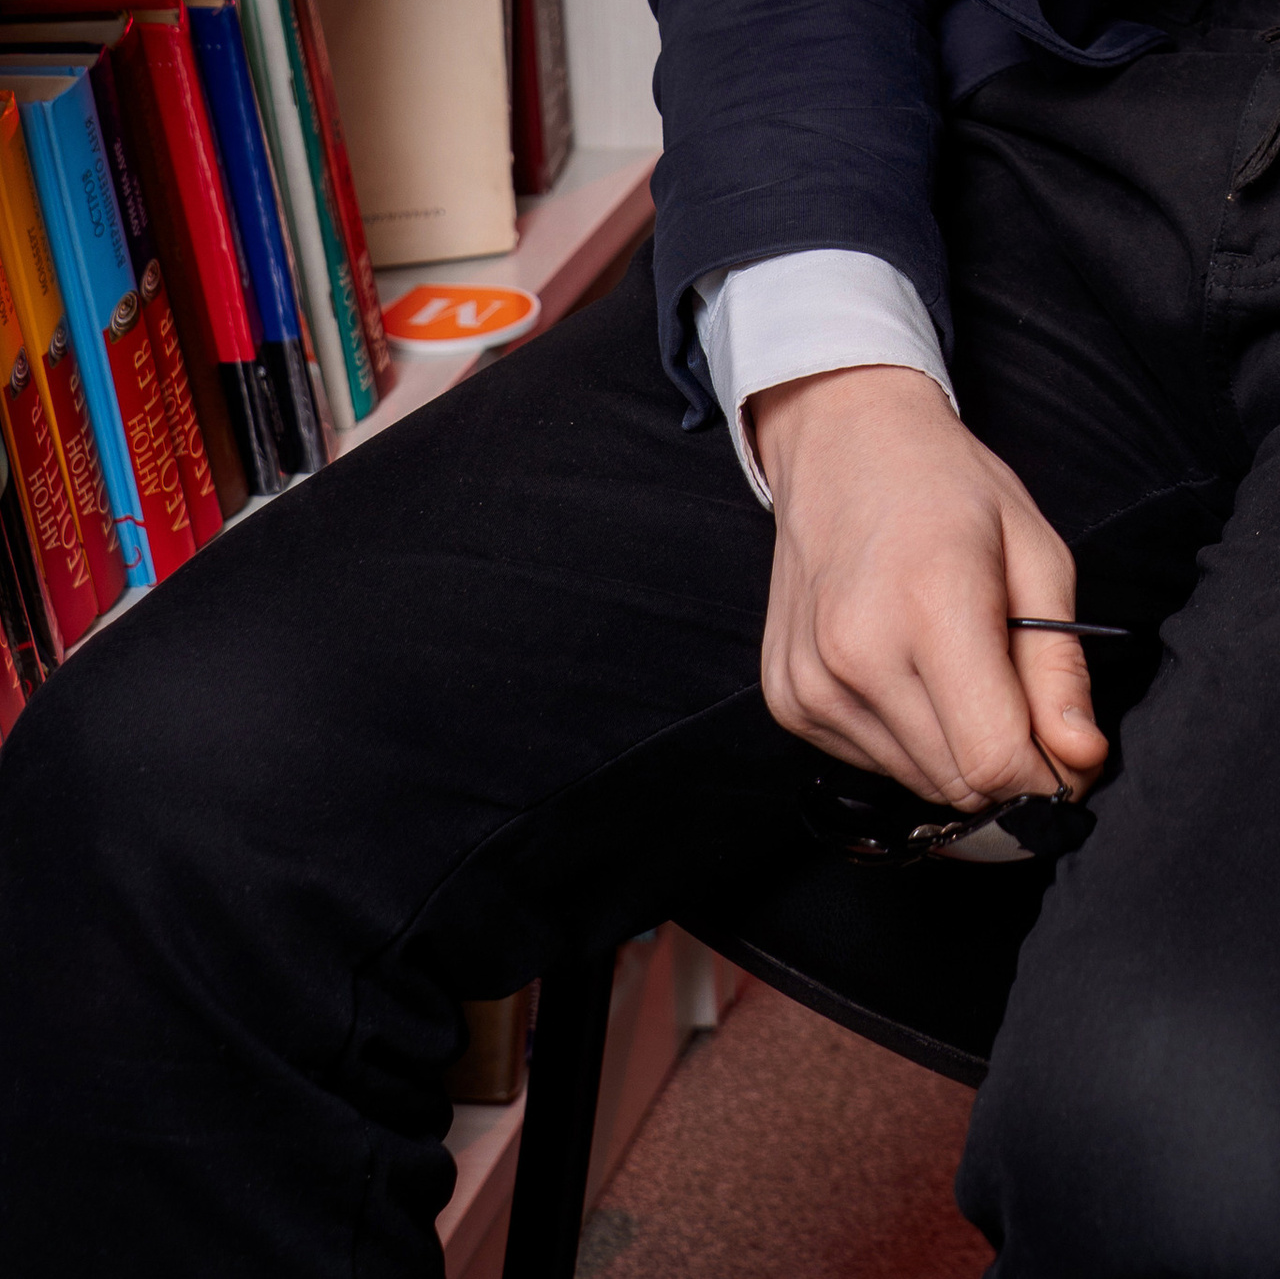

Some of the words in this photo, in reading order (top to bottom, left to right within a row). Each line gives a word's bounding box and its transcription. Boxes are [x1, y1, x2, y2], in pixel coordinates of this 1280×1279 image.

[85, 116, 100, 154] ДНЯ
[81, 169, 104, 238] ОСТРОВ
[94, 156, 125, 270] ВЧЕРАШНЕГО
[27, 226, 49, 296] МОЛЬБЕРТ
[133, 338, 190, 533] ЛЕОНТЬЕВ
[160, 307, 216, 498] ЛЕОНТЬЕВ
[162, 378, 189, 457] АНТОН
[31, 394, 91, 590] ЛЕОНТЬЕВ
[65, 437, 98, 517] АНТОН
[127, 413, 160, 497] АНТОН
[28, 471, 60, 551] АНТОН
